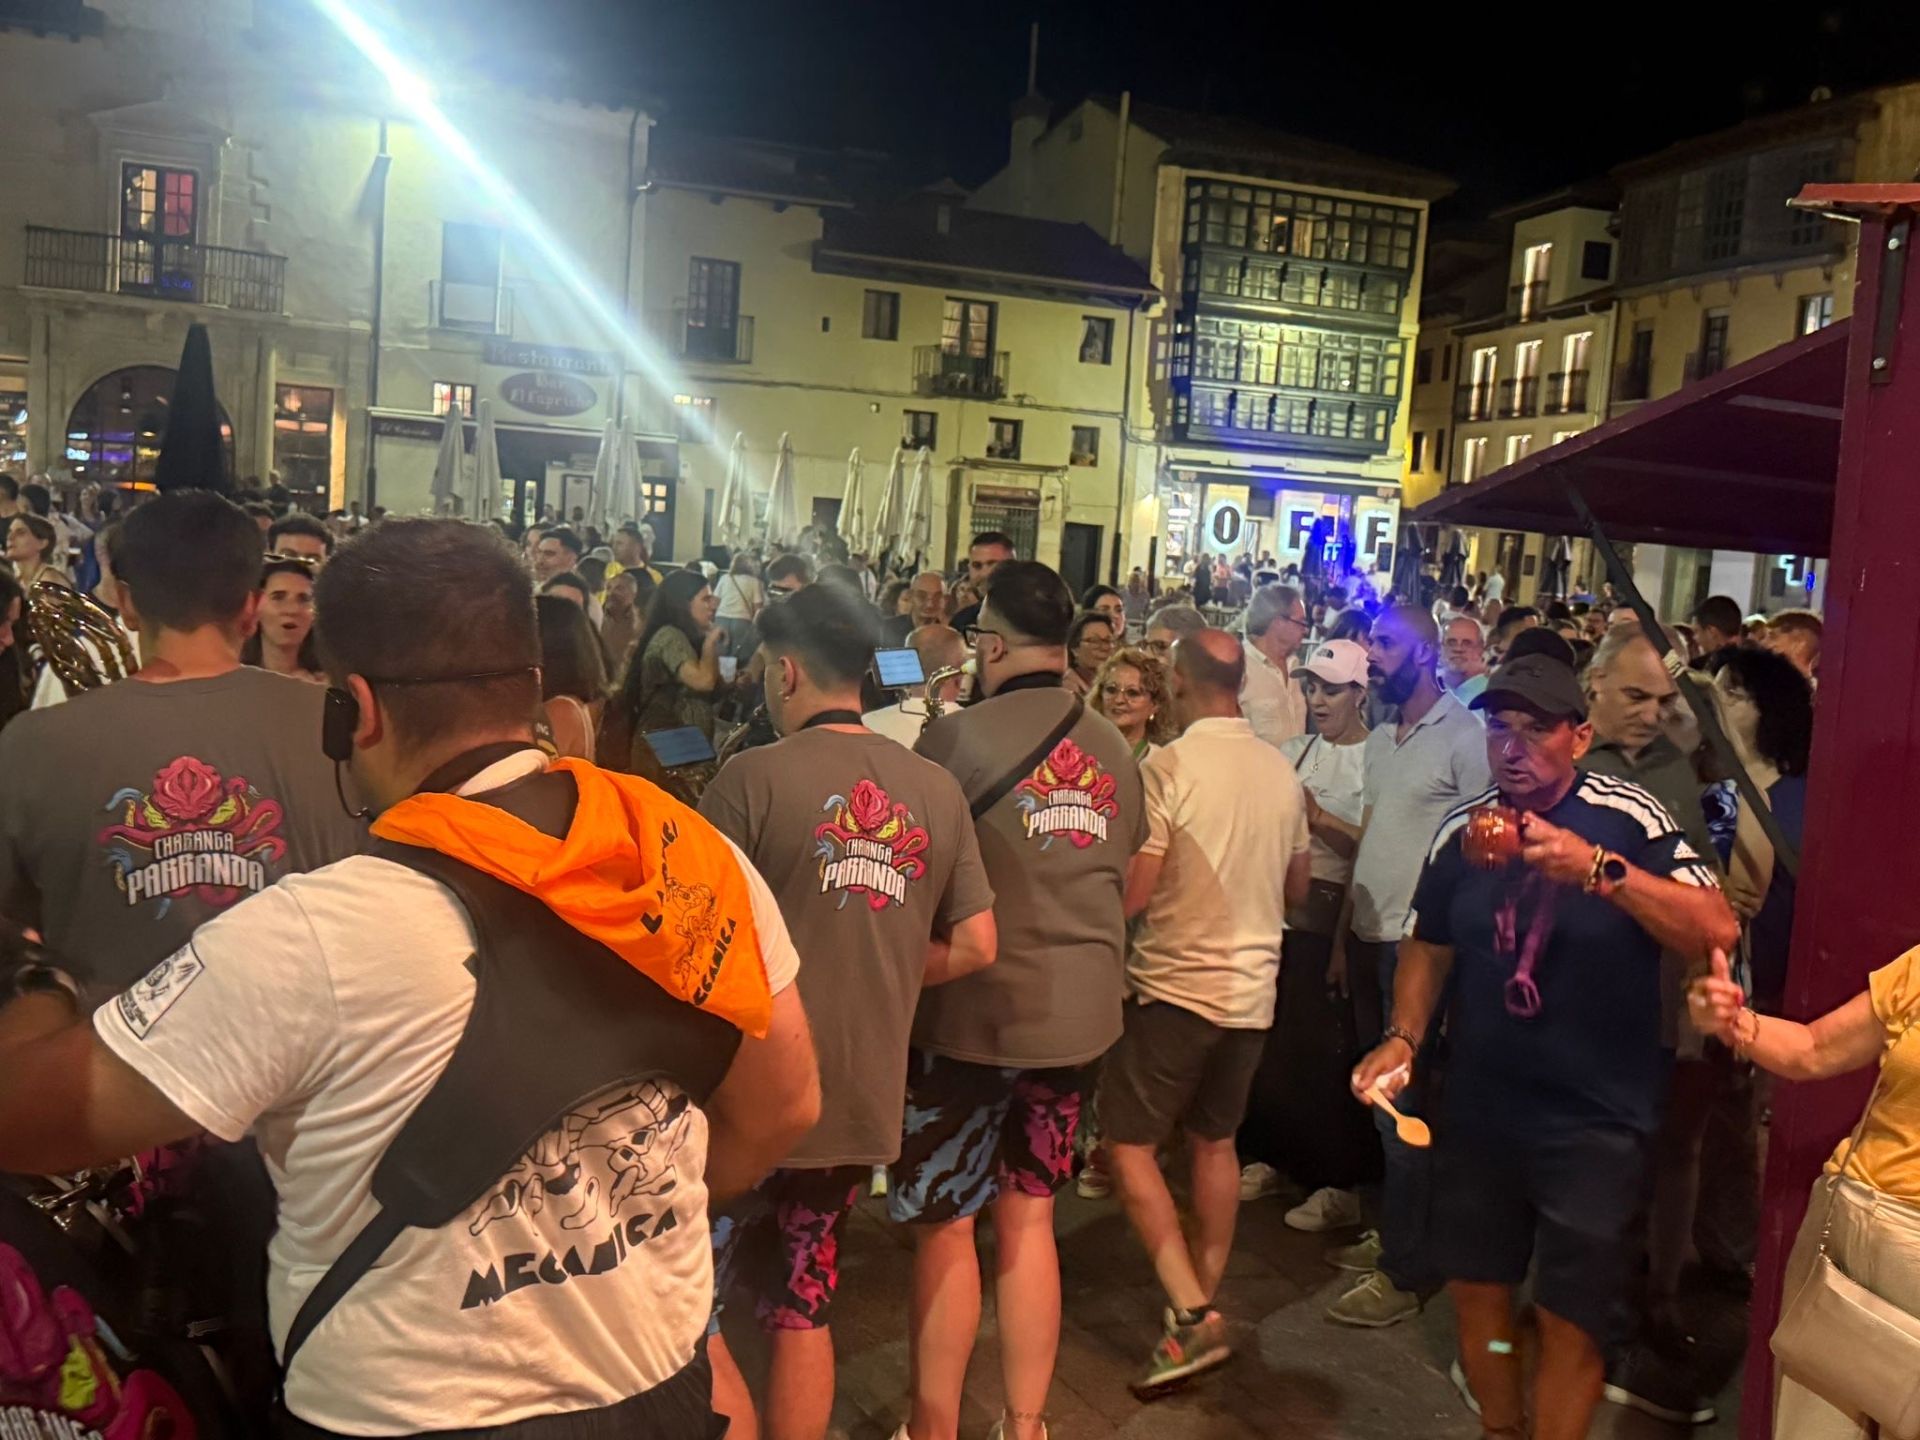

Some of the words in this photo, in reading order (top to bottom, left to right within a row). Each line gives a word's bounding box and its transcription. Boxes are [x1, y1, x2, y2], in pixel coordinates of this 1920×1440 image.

[1048, 788, 1092, 808] CHARANGA
[1026, 805, 1107, 841] PARRANDA
[154, 830, 234, 860] CHARANGA
[126, 853, 265, 906] PARRANDA
[821, 857, 906, 905] PARRANDA
